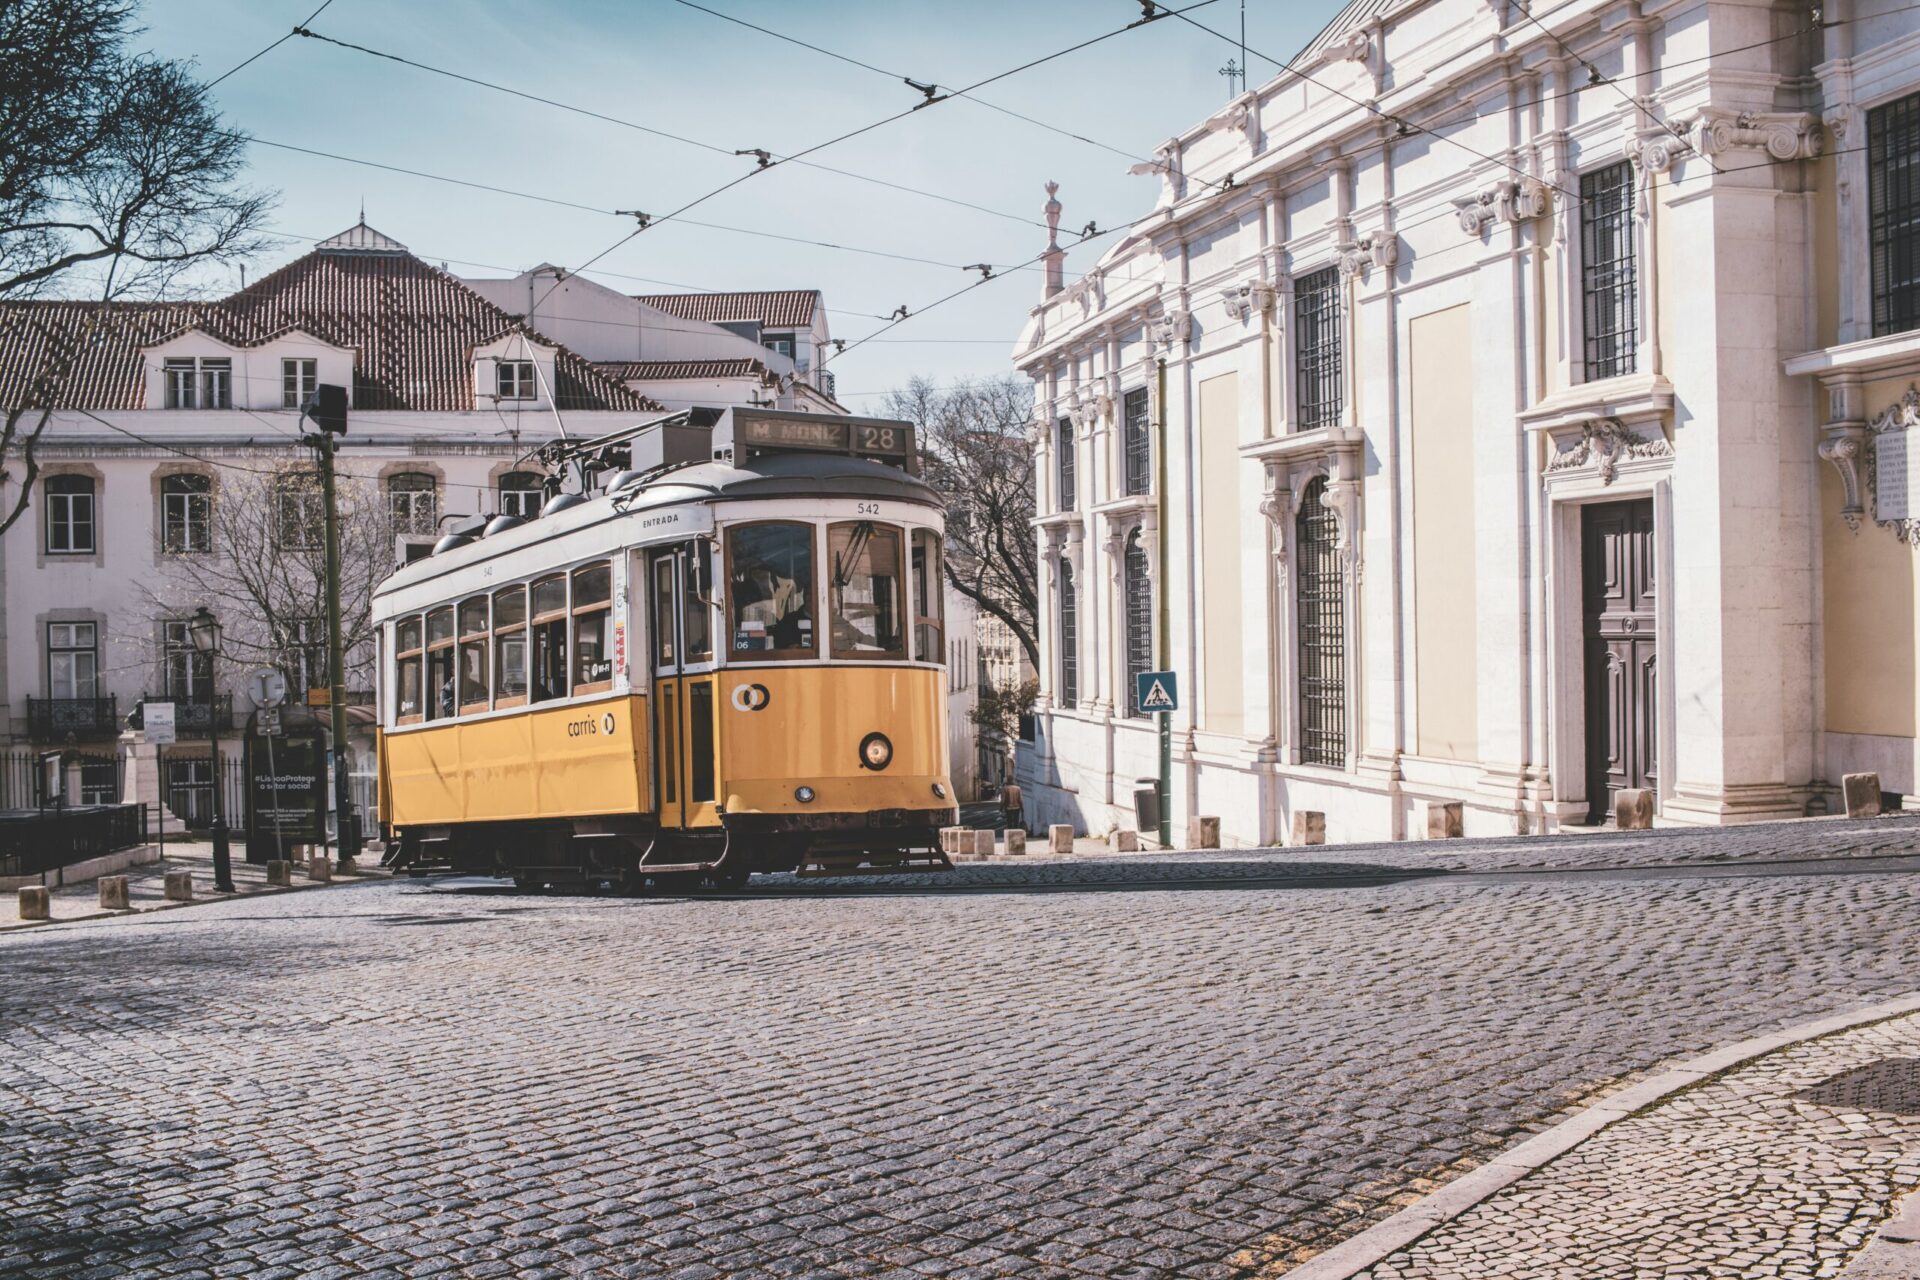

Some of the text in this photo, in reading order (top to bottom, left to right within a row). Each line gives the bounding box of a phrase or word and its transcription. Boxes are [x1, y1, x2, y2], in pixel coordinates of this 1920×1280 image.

[782, 424, 841, 440] MONIZ
[865, 428, 894, 449] 28
[857, 503, 880, 515] 542
[643, 514, 679, 528] ENTRADA
[736, 641, 749, 649] 06
[567, 714, 597, 737] carris
[287, 782, 311, 790] social
